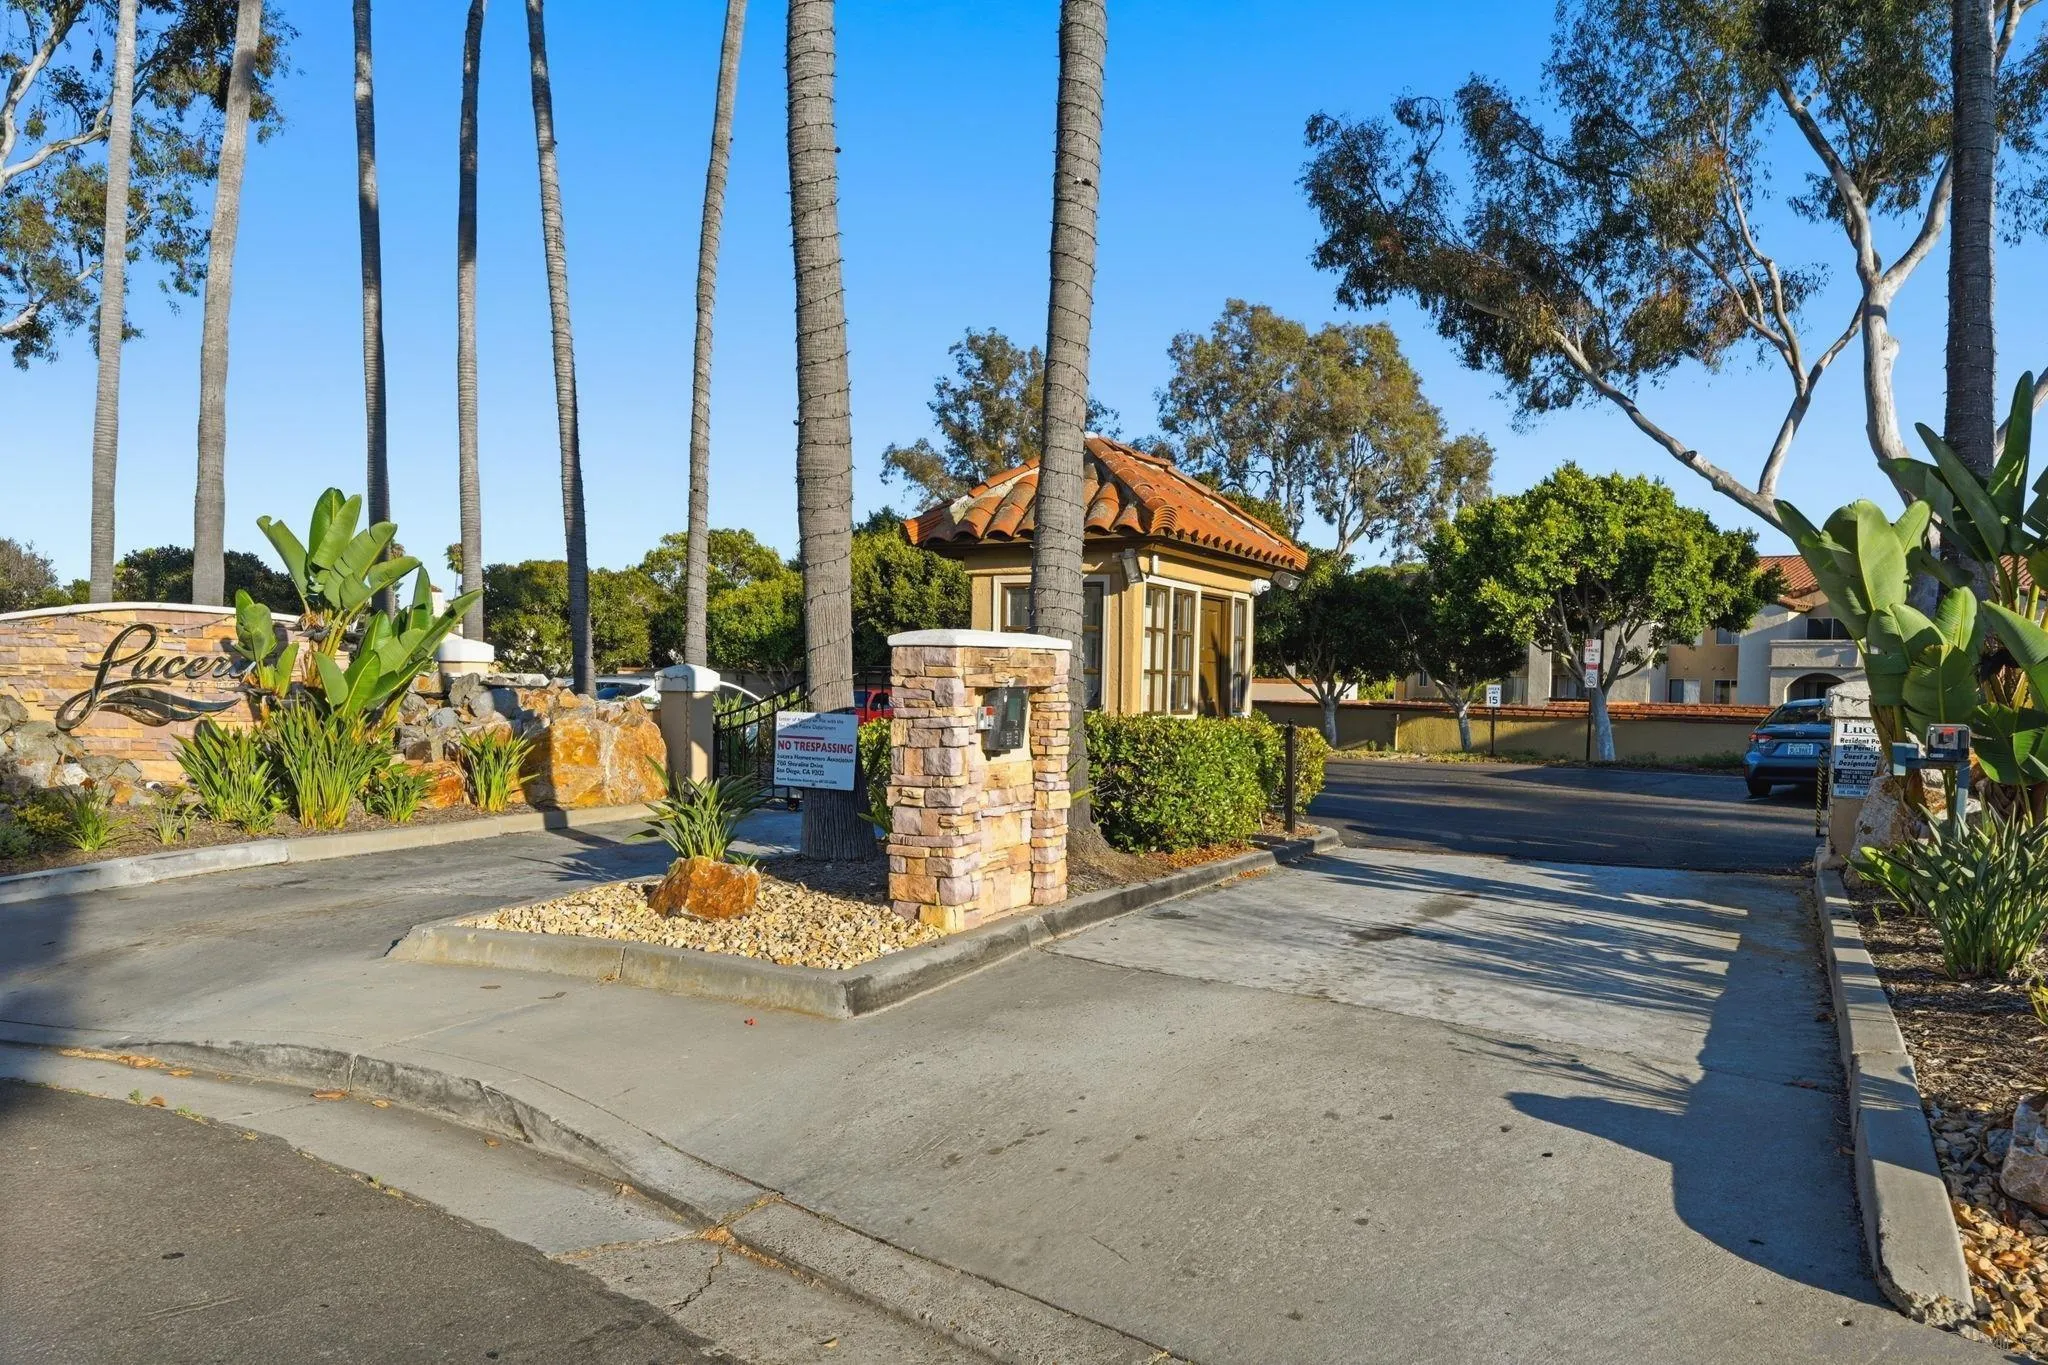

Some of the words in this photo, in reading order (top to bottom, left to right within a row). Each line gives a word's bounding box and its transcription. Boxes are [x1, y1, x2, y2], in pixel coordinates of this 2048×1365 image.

[56, 624, 257, 730] Lucera
[186, 681, 207, 693] AT
[1489, 696, 1498, 704] 15
[1843, 723, 1877, 734] Luce
[778, 740, 792, 750] NO
[794, 741, 853, 754] TRESPASSING
